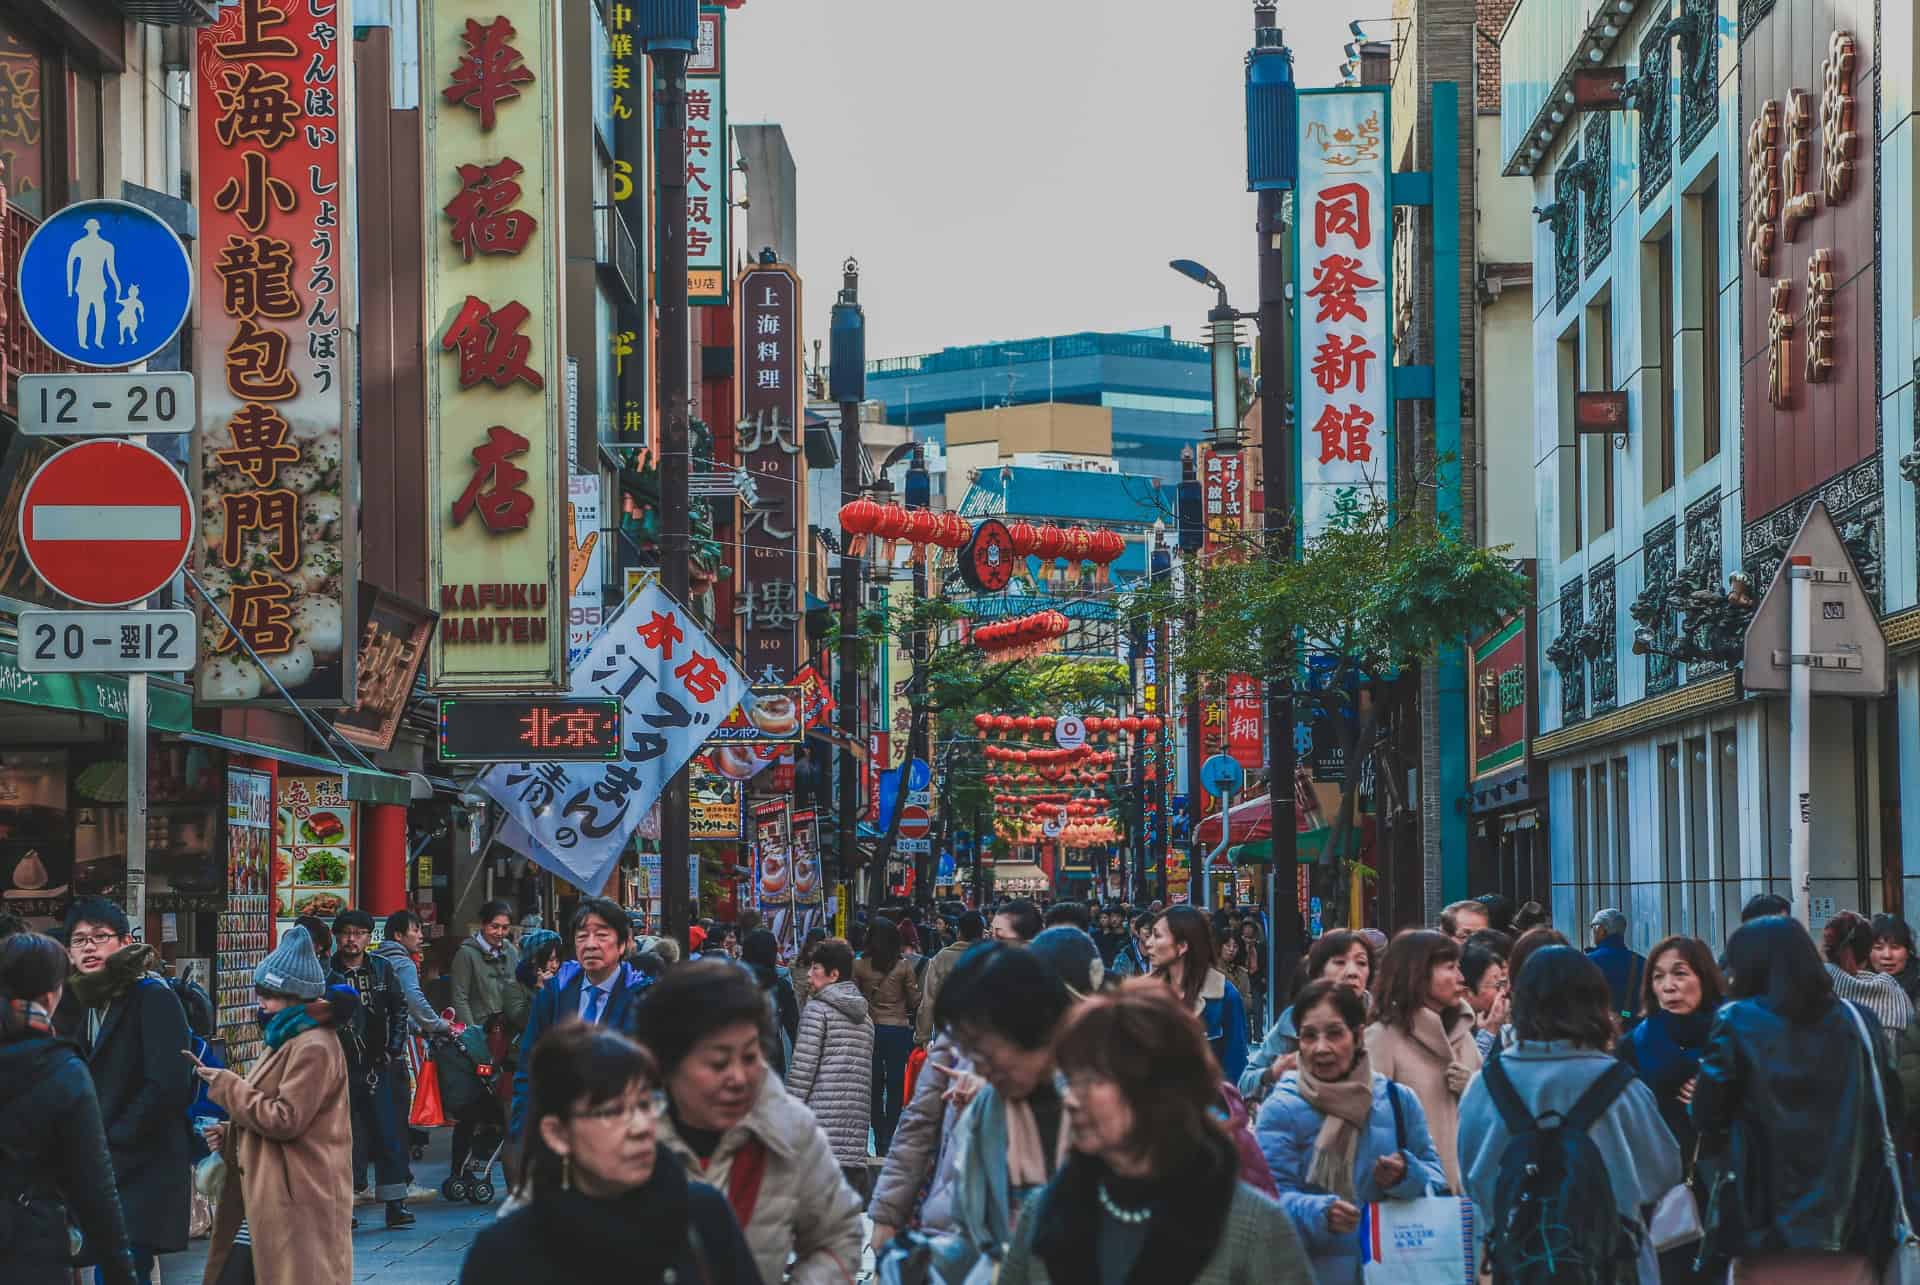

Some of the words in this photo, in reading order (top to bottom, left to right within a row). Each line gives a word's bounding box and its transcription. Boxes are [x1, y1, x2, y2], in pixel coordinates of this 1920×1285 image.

[307, 165, 339, 393] しょうろんぽう
[441, 15, 545, 532] 華福飯店
[757, 287, 781, 389] 上海料理
[41, 385, 177, 423] 12-20
[760, 461, 779, 473] JO
[441, 583, 547, 611] KAFUKU
[441, 617, 547, 643] HANTEN
[760, 639, 781, 650] RO
[637, 610, 727, 703] 本店
[519, 706, 612, 748] 北京
